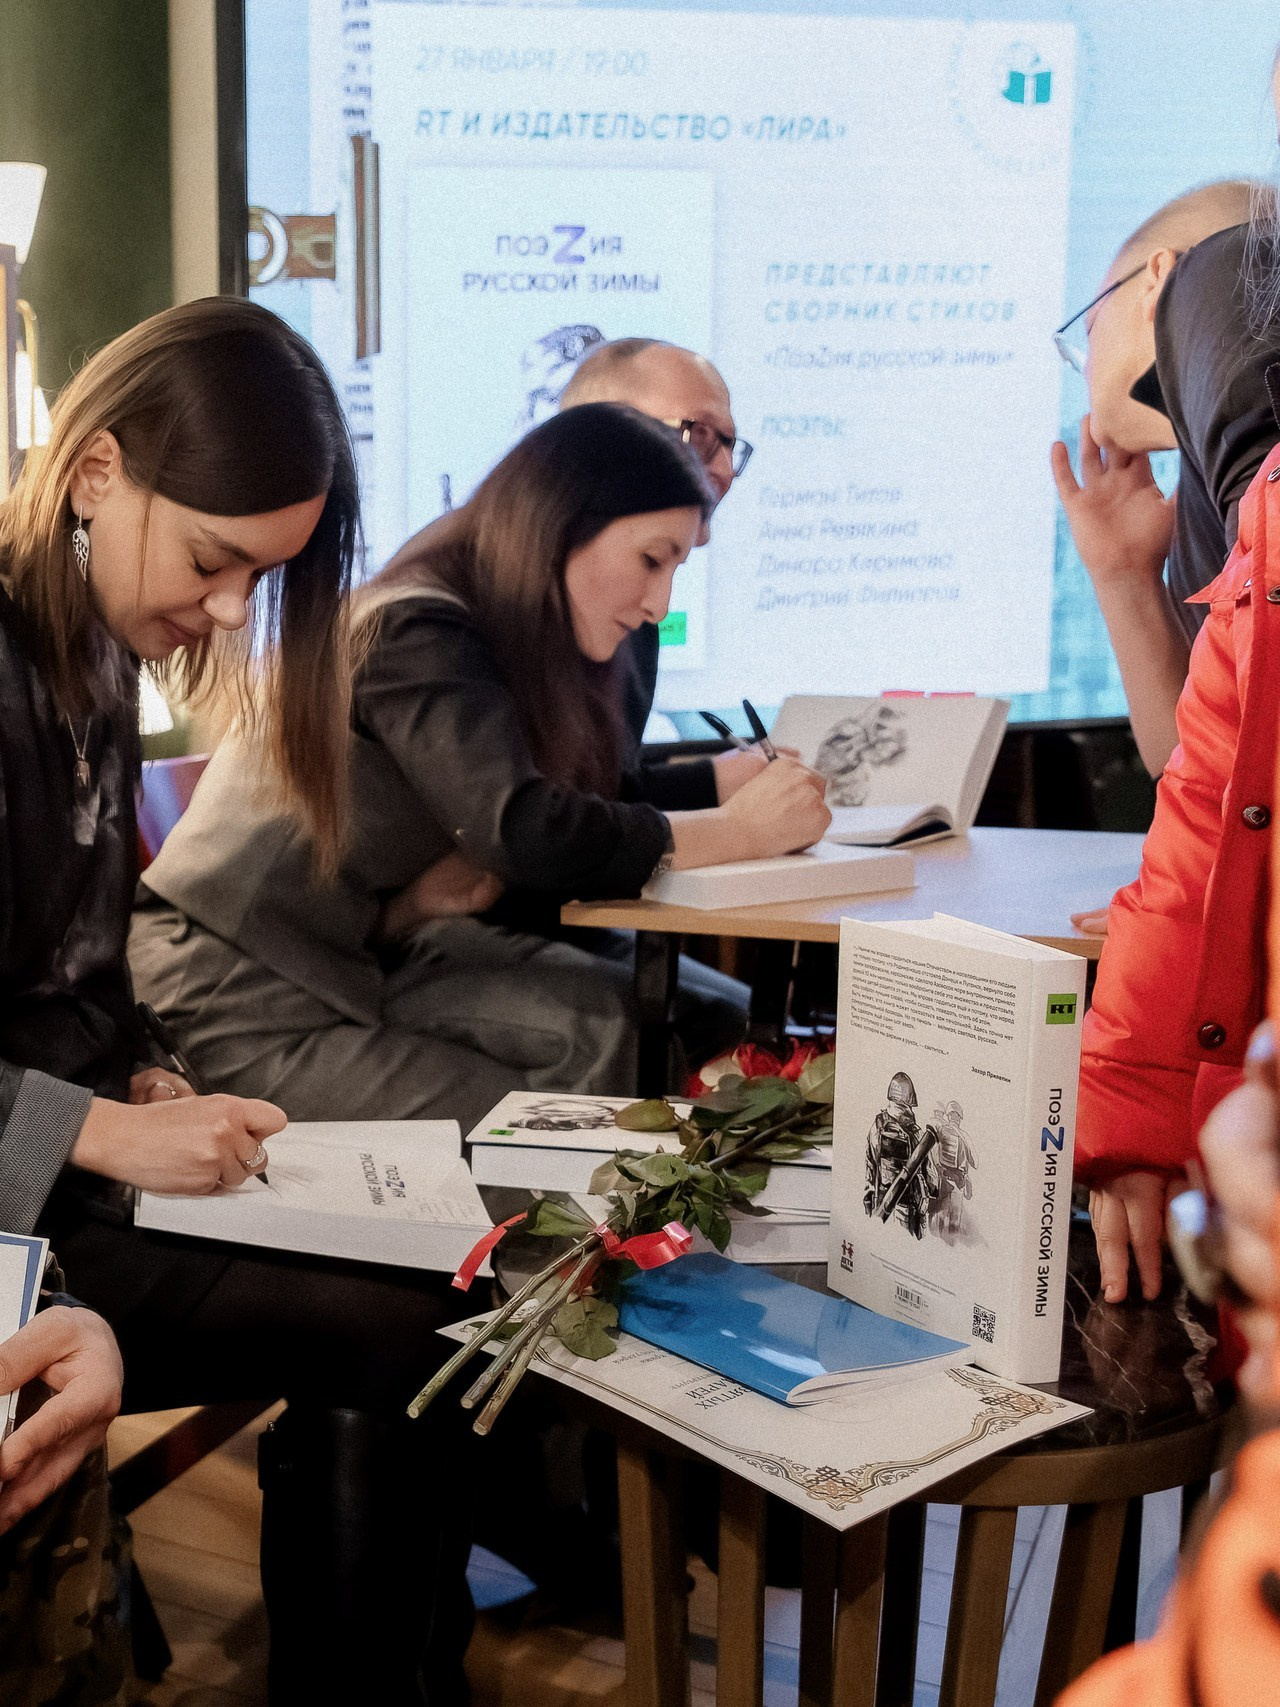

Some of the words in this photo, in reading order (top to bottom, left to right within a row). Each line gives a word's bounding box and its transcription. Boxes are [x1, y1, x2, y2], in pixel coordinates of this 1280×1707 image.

[451, 46, 556, 73] ЯНВАРЯ
[416, 109, 452, 137] RT
[460, 111, 482, 138] И
[490, 110, 732, 142] ИЗДАТЕЛЬСТВО
[740, 114, 847, 142] «ЛИРА»
[462, 269, 578, 293] РУССКОЙ
[587, 272, 660, 293] ЗИМЫ
[764, 261, 993, 287] ПРЕДСТАВЛЯЮТ
[763, 299, 898, 323] СБОРНИК
[907, 299, 1017, 323] СТИХОВ
[1049, 1003, 1077, 1015] RT
[1040, 1088, 1065, 1177] ПОЭZИЯ
[1038, 1182, 1056, 1261] РУССКОЙ
[1034, 1265, 1051, 1318] ЗИМЫ
[694, 1386, 752, 1411] ВЯТЫХ
